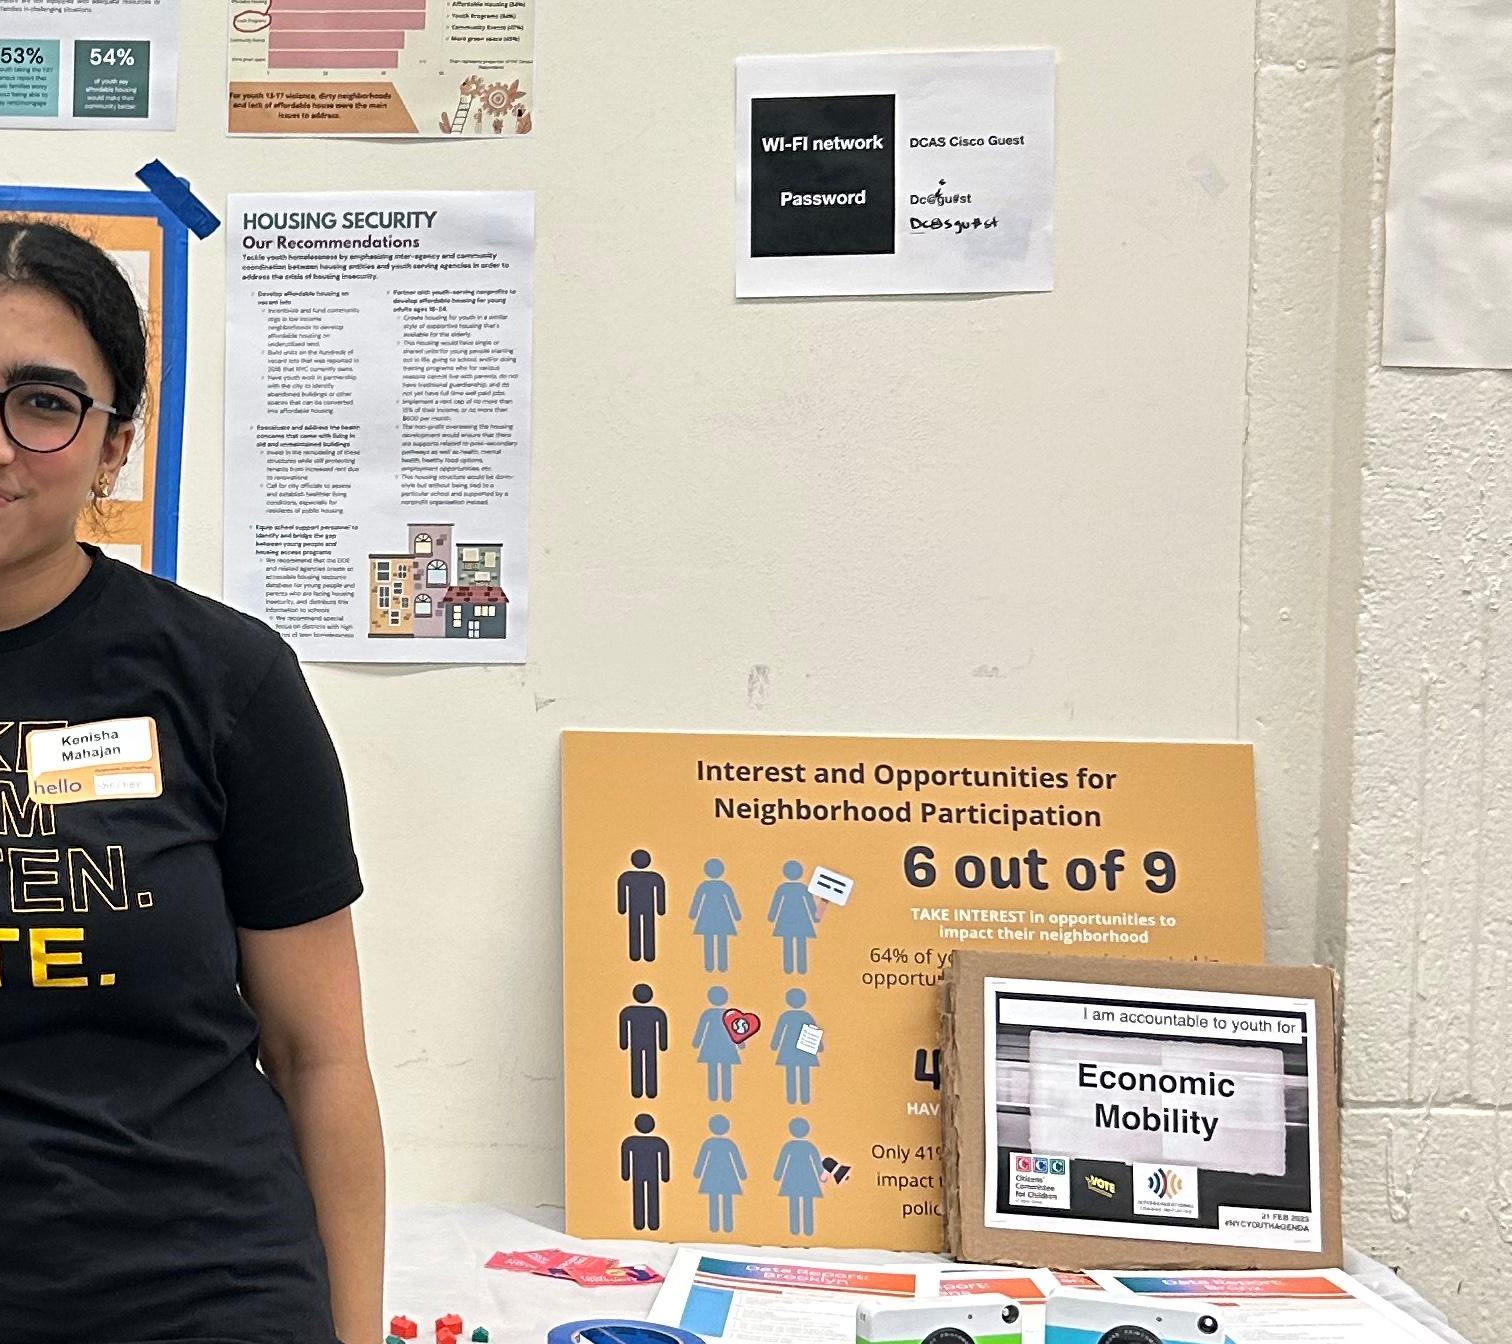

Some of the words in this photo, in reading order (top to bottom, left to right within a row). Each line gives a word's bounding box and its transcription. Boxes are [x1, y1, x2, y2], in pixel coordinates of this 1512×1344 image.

[0, 47, 44, 64] 53%
[89, 48, 135, 66] 54%
[762, 136, 808, 152] WI-FI
[812, 135, 884, 151] network
[909, 137, 946, 148] DCAS
[949, 136, 985, 147] Cisco
[988, 135, 1025, 147] Guest
[780, 189, 866, 206] Password
[243, 212, 337, 230] HOUSING
[342, 211, 438, 229] SECURITY
[242, 236, 273, 249] Our
[277, 234, 420, 249] Recommendations
[62, 746, 121, 762] Mahajan
[697, 760, 806, 784] Interest
[814, 762, 865, 784] and
[873, 763, 1069, 792] Opportunities
[1076, 767, 1118, 790] for
[34, 778, 82, 795] hello
[714, 797, 912, 826] Neighborhood
[920, 801, 1102, 831] Participation
[903, 845, 937, 888] 6
[954, 848, 1049, 891] out
[1065, 848, 1126, 892] of
[1143, 850, 1177, 894] 9
[911, 908, 950, 922] TAKE
[953, 909, 1027, 924] INTEREST
[1029, 910, 1046, 924] in
[1048, 911, 1156, 930] opportunities
[1159, 914, 1177, 928] to
[939, 925, 994, 941] impact
[997, 926, 1036, 942] their
[1039, 928, 1149, 945] neighborhood
[869, 947, 909, 964] 64%
[914, 948, 934, 964] of
[1083, 1007, 1087, 1020] I
[1092, 1010, 1116, 1023] am
[1119, 1010, 1208, 1029] accountable
[1213, 1016, 1227, 1030] to
[1232, 1017, 1272, 1034] youth
[1277, 1019, 1296, 1035] for
[1078, 1062, 1236, 1098] Economic
[1094, 1103, 1219, 1141] Mobility
[871, 1144, 911, 1163] Only
[876, 1172, 935, 1190] impact
[902, 1201, 942, 1218] polic
